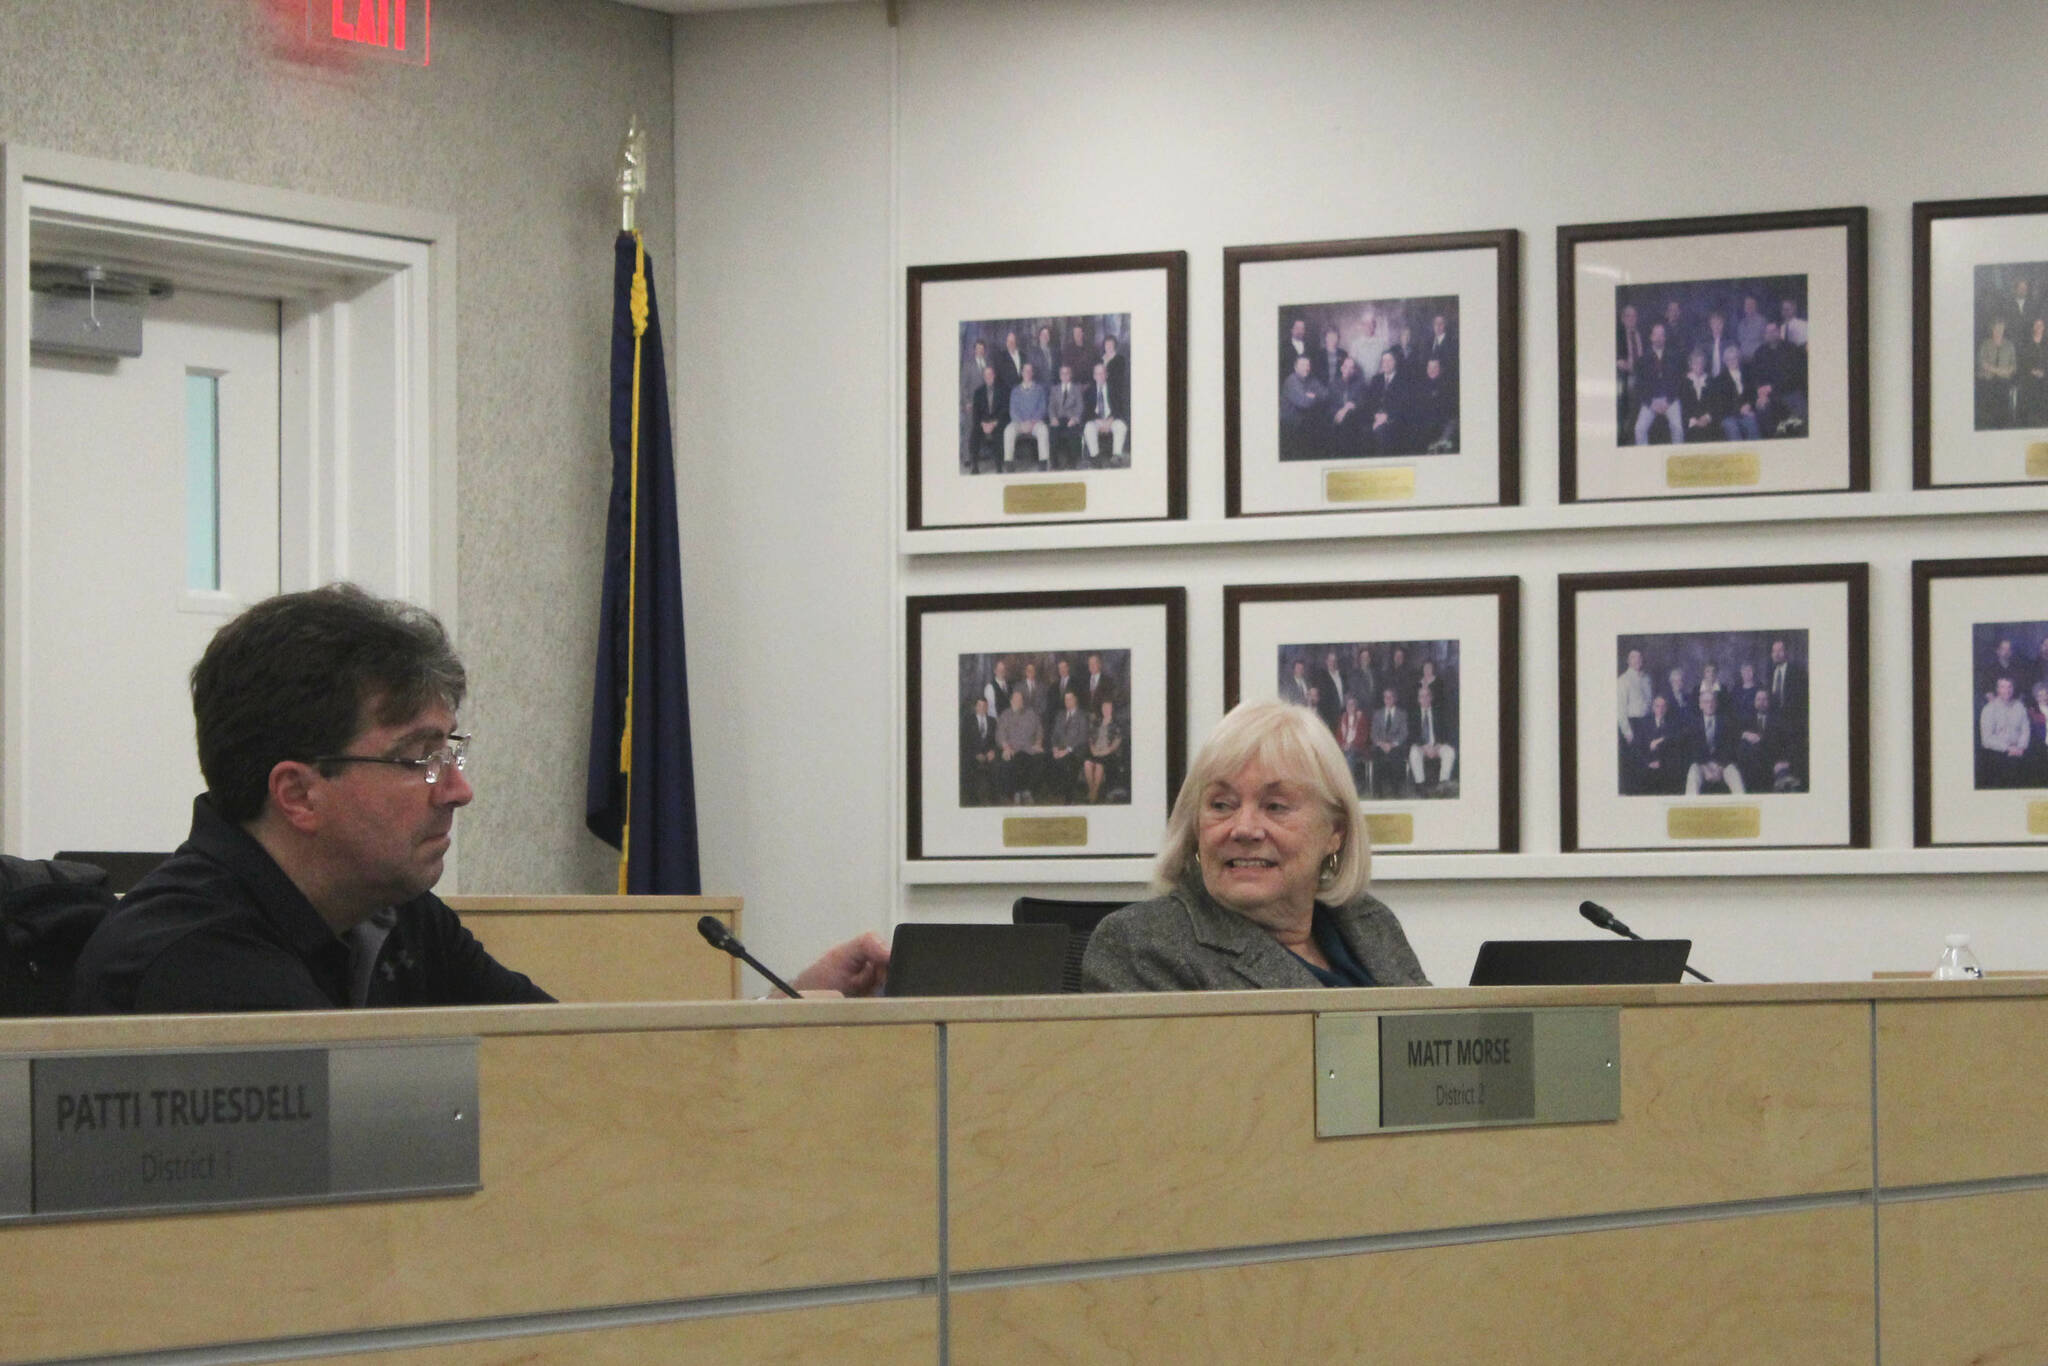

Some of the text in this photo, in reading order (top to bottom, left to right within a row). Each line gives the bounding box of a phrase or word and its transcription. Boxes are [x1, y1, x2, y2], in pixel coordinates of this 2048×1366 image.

[1408, 1037, 1511, 1068] MATT MORSE
[57, 1084, 312, 1131] PATTI TRUESDELL
[1436, 1081, 1487, 1107] District 2
[142, 1150, 216, 1184] District
